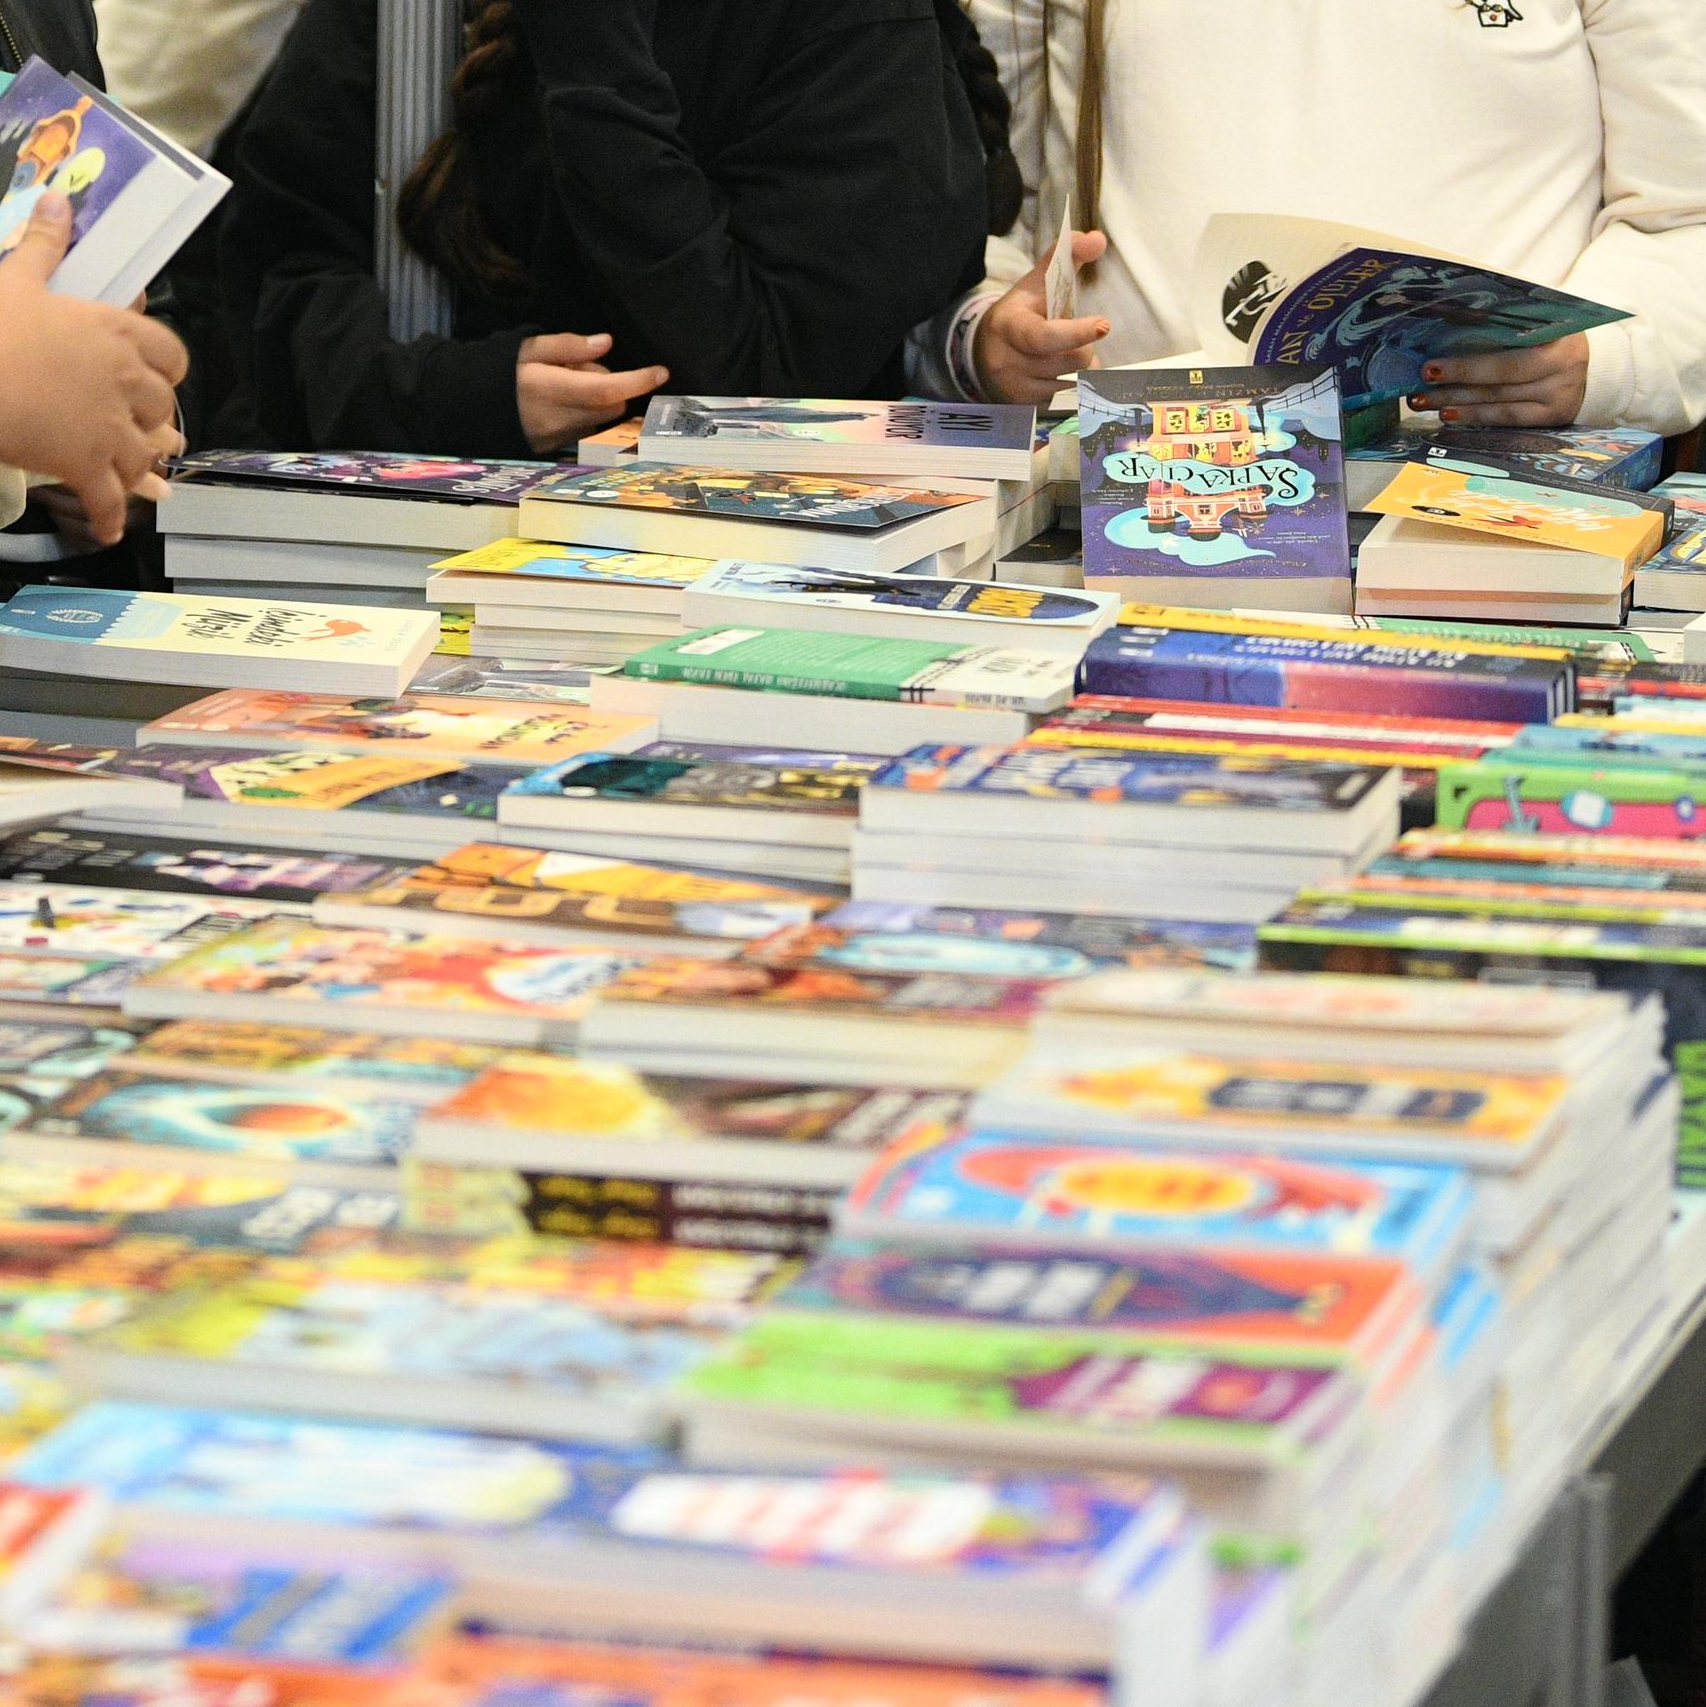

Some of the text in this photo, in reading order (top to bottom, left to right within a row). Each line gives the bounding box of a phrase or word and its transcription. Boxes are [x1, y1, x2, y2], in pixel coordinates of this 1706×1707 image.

[938, 412, 993, 432] AYI
[1112, 455, 1300, 502] ŞAPKACILAR
[181, 608, 253, 642] Müzik
[245, 606, 327, 648] İçimdeki
